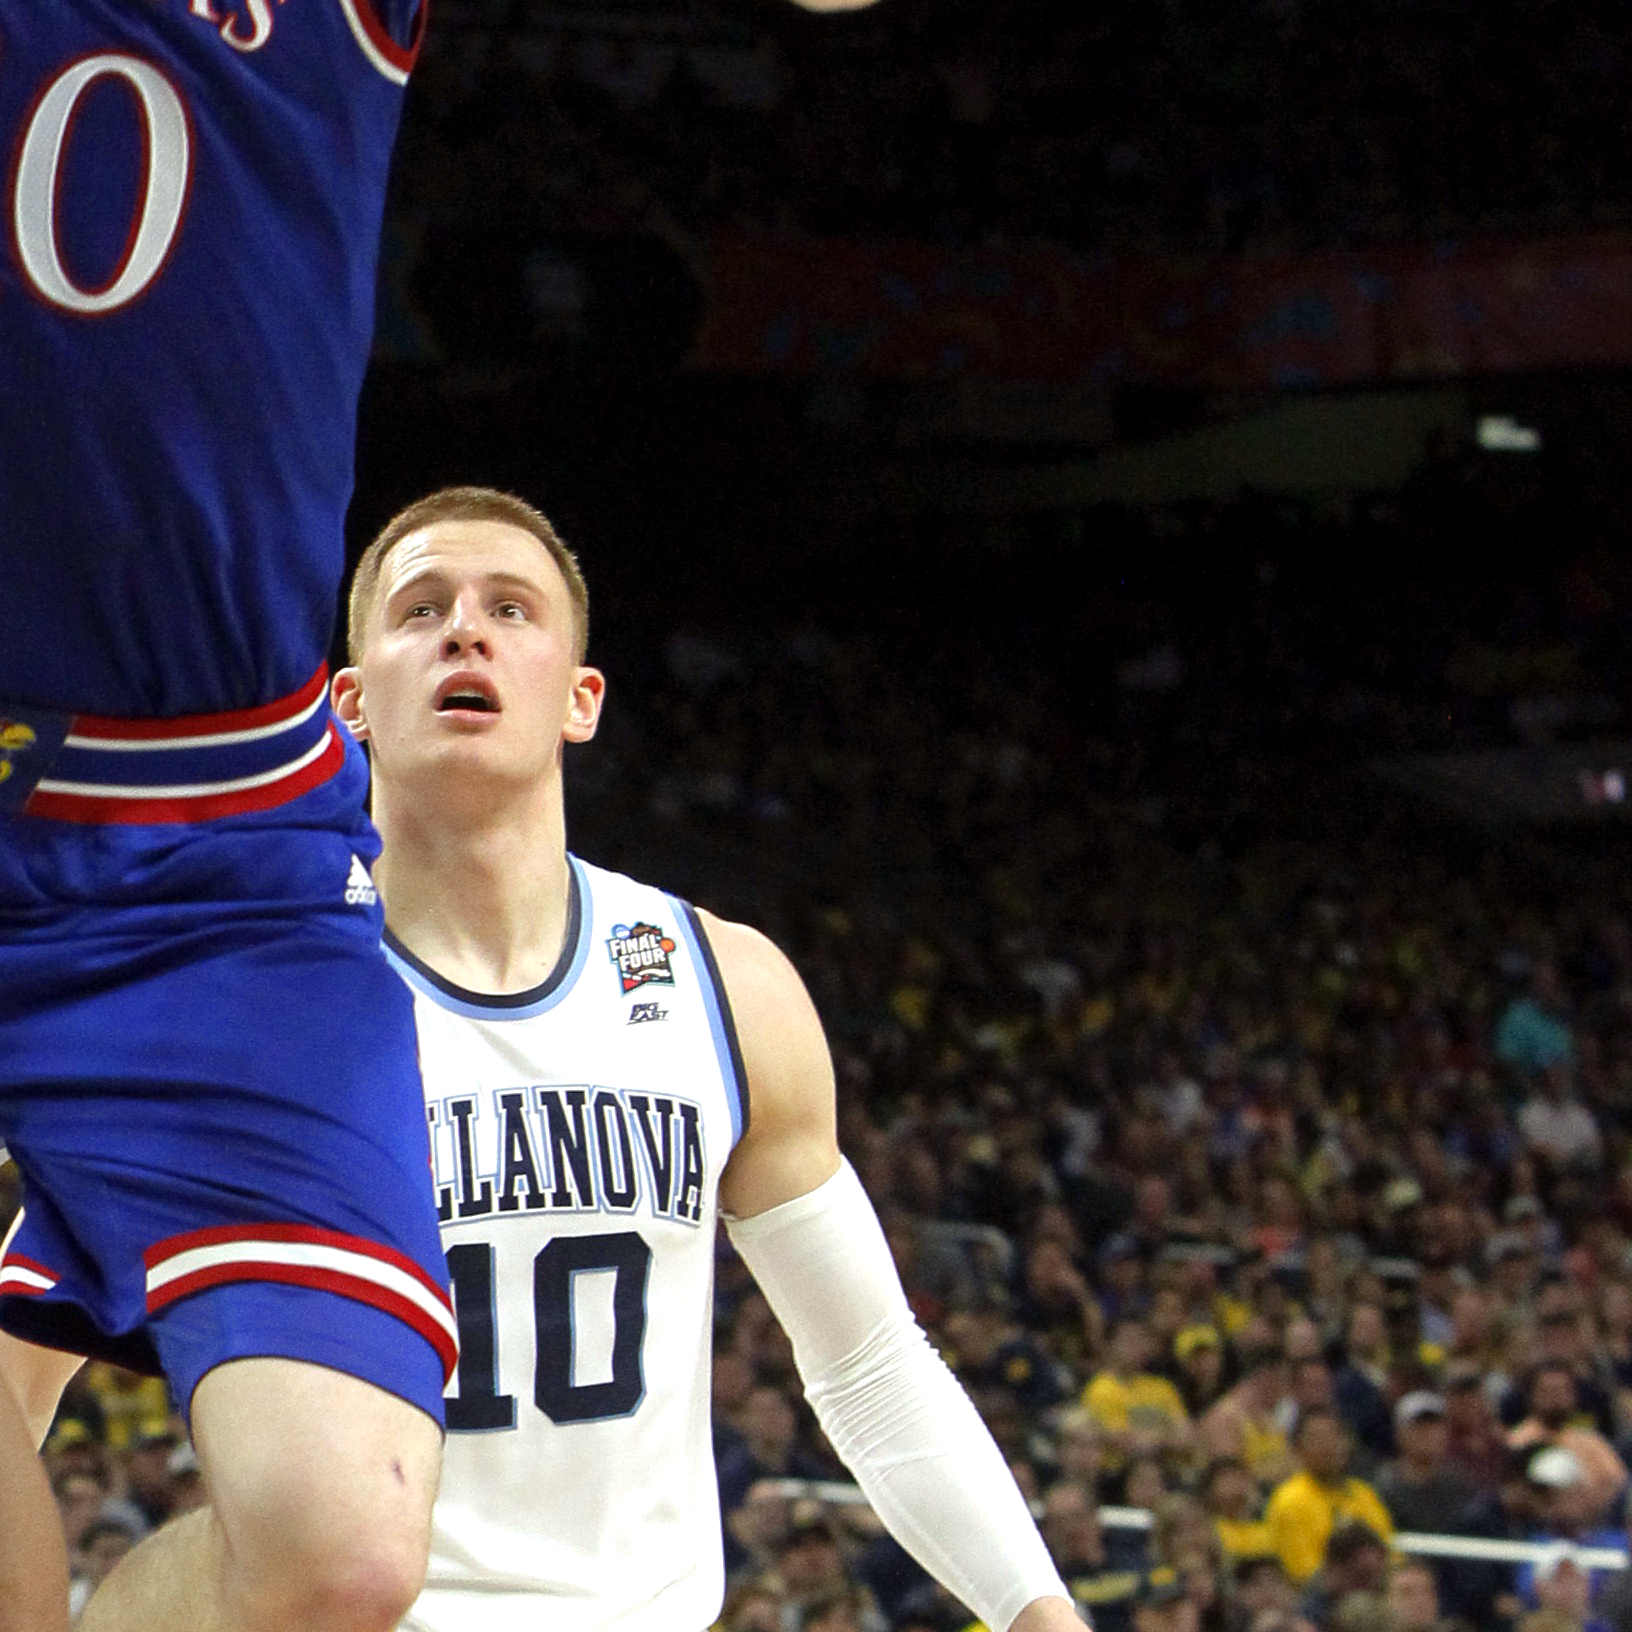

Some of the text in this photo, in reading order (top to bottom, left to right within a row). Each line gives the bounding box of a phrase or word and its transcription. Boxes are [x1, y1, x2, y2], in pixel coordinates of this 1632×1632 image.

[609, 933, 660, 960] FINAL
[619, 948, 666, 972] FOUR
[445, 1231, 652, 1434] 10
